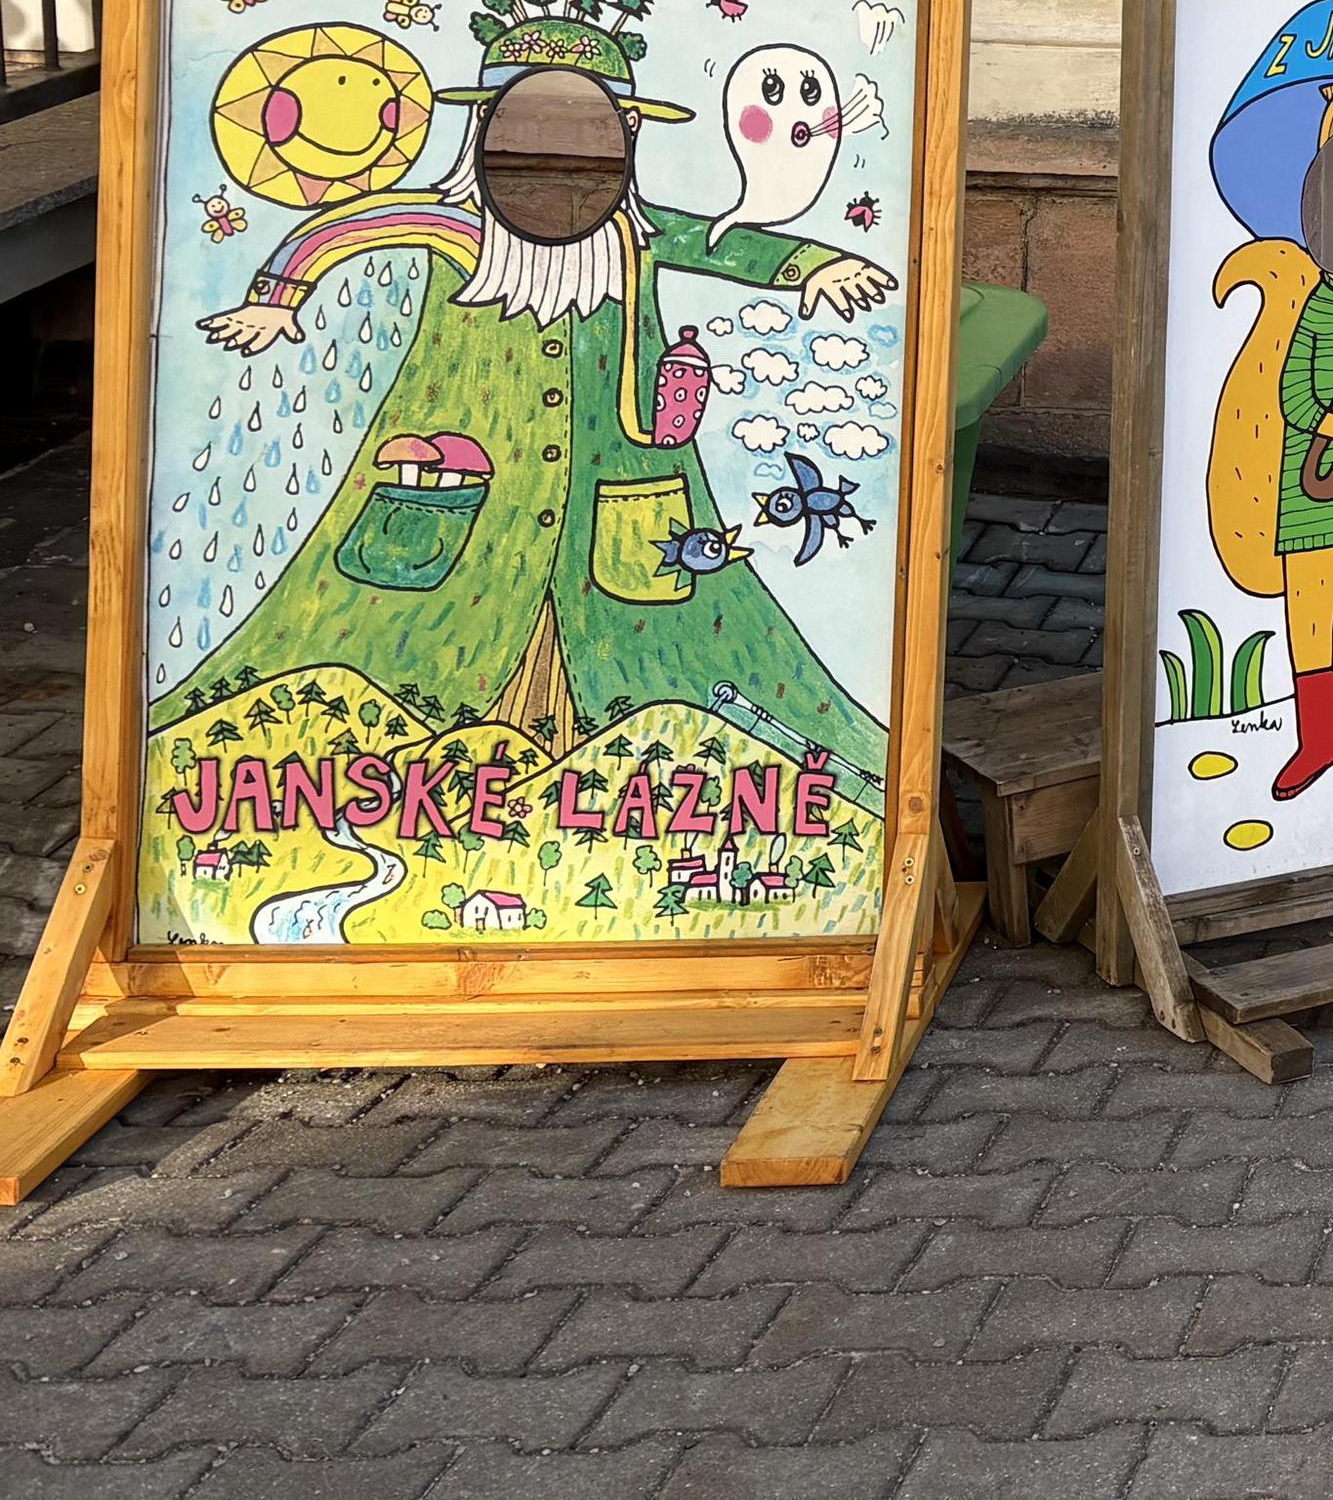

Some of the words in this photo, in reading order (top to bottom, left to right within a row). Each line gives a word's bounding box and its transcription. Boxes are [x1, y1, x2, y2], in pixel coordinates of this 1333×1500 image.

[1264, 33, 1296, 78] Z
[172, 741, 510, 839] JANSKÉ
[556, 750, 836, 839] LÁZNĚ
